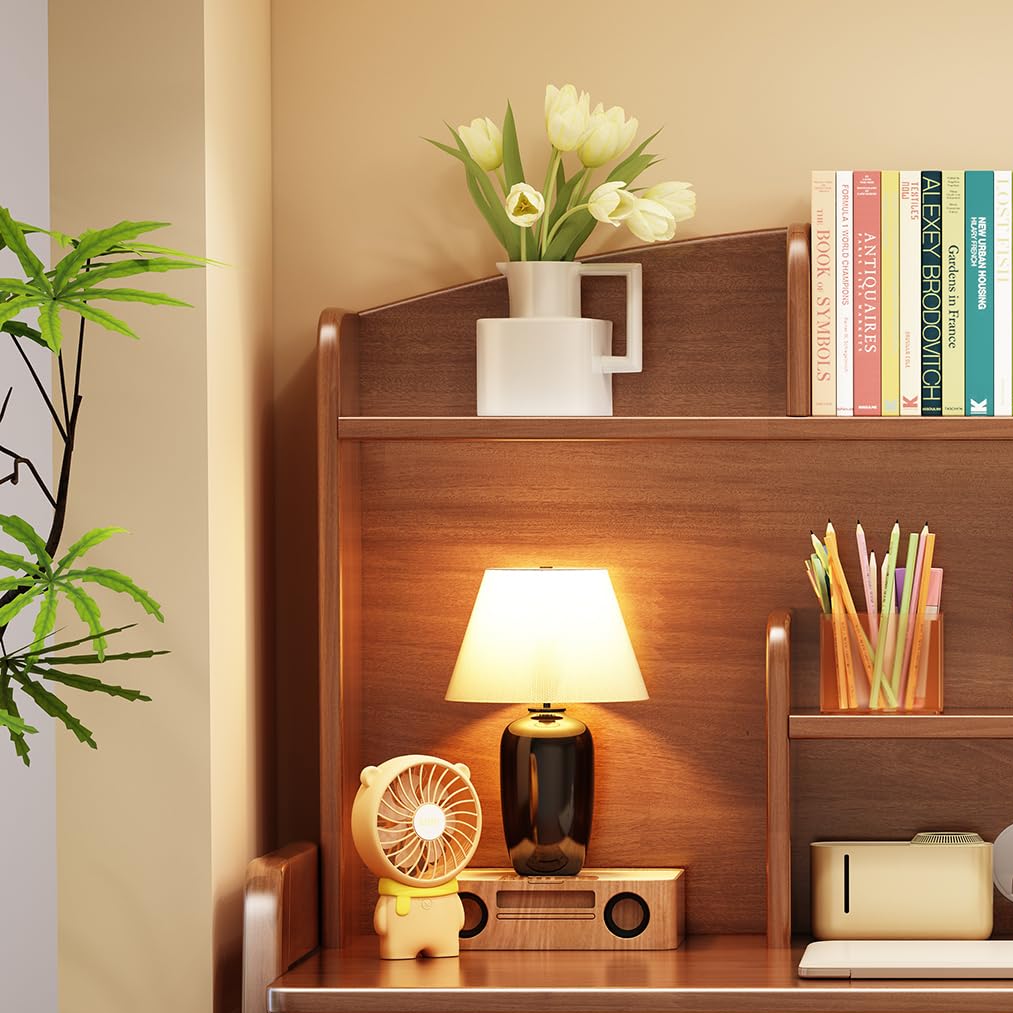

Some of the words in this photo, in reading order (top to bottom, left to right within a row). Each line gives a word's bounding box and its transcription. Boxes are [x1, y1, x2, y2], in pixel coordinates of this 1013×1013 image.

[911, 181, 919, 220] TEXTILES
[922, 176, 941, 259] ALEXEY
[978, 217, 986, 236] NEW
[816, 229, 831, 278] BOOK
[948, 245, 959, 292] Gardens
[978, 238, 986, 269] URBAN
[862, 232, 877, 353] ANTIQUAIRES
[948, 295, 960, 306] in
[978, 270, 986, 310] HOUSING
[816, 296, 831, 382] SYMBOLS
[922, 265, 941, 400] BRODOVITCH
[948, 310, 960, 349] France
